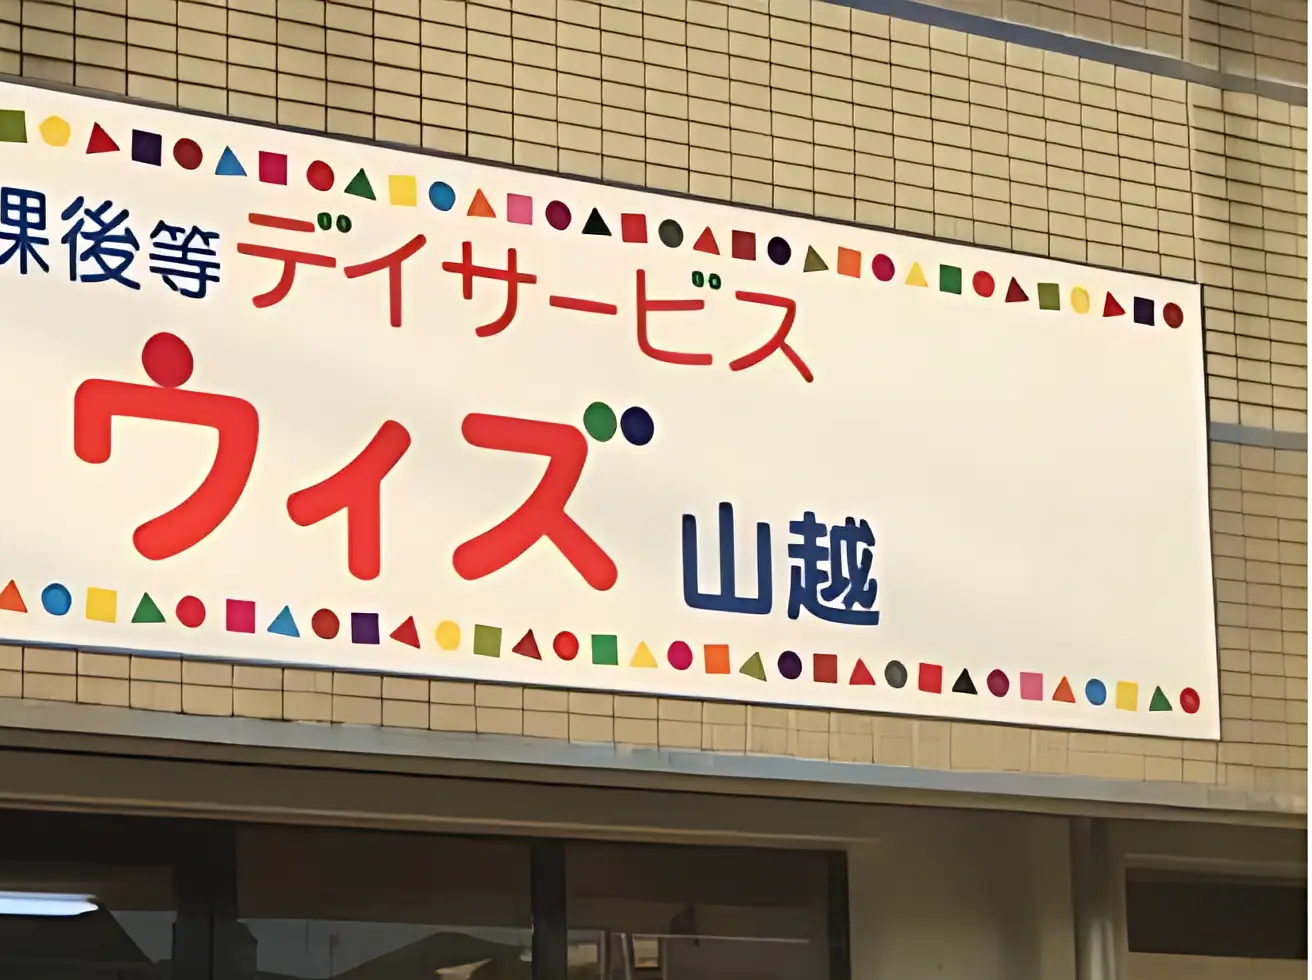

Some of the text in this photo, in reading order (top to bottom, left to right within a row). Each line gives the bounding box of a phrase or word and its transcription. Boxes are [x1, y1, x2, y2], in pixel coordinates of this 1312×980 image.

[73, 331, 881, 628] ウィズ 山越
